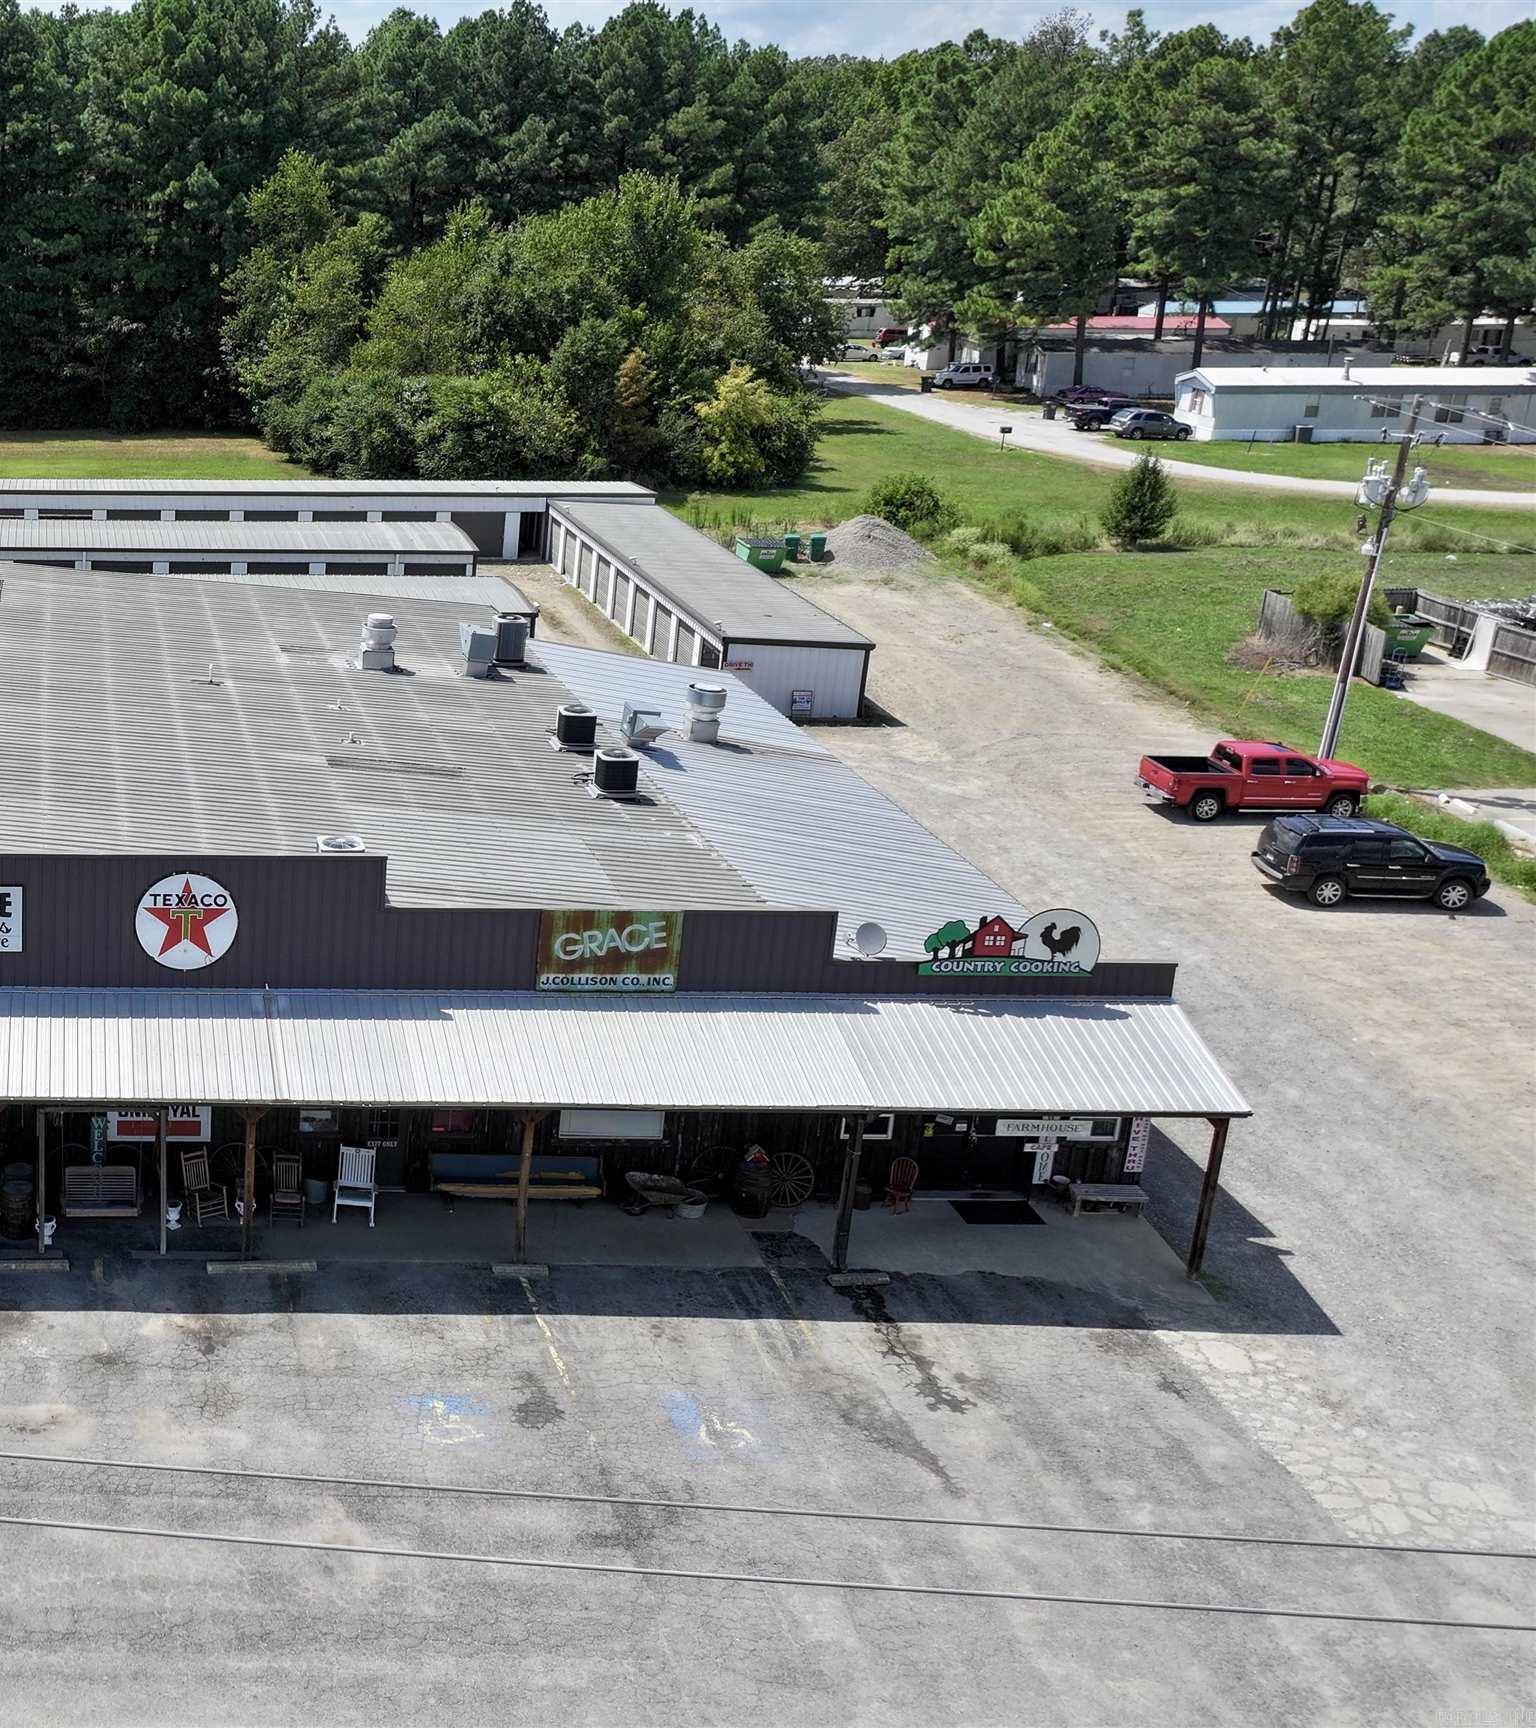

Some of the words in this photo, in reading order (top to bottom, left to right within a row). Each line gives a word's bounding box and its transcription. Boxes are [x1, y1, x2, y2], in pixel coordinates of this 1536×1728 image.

[149, 893, 228, 907] TEXACO
[554, 921, 667, 960] GRACE
[931, 961, 1005, 973] COUNTRY
[1010, 961, 1081, 973] COOKING
[1007, 1123, 1081, 1133] FARMHOUSE
